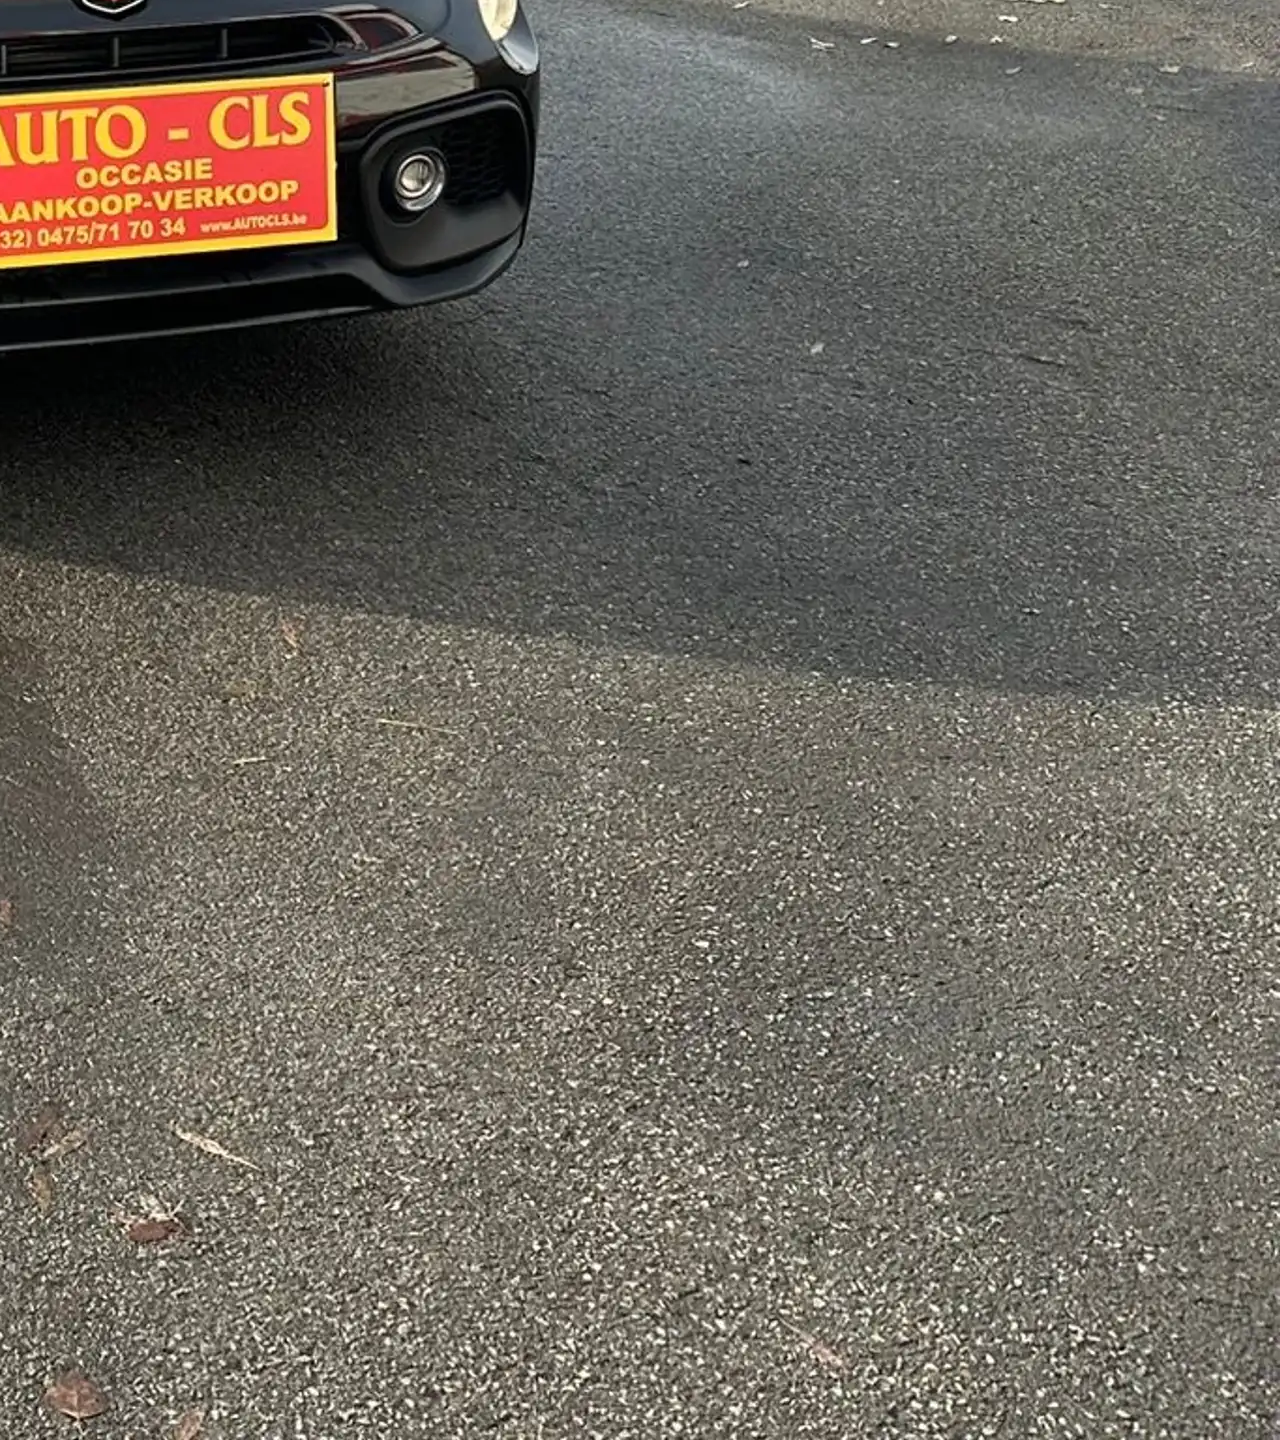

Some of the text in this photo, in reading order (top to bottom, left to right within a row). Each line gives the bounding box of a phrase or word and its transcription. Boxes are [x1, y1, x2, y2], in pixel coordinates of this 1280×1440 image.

[207, 91, 313, 152] CLS
[75, 157, 214, 189] OCCASIE
[36, 220, 120, 248] 0475/71
[127, 220, 155, 240] 70
[159, 217, 187, 238] 34
